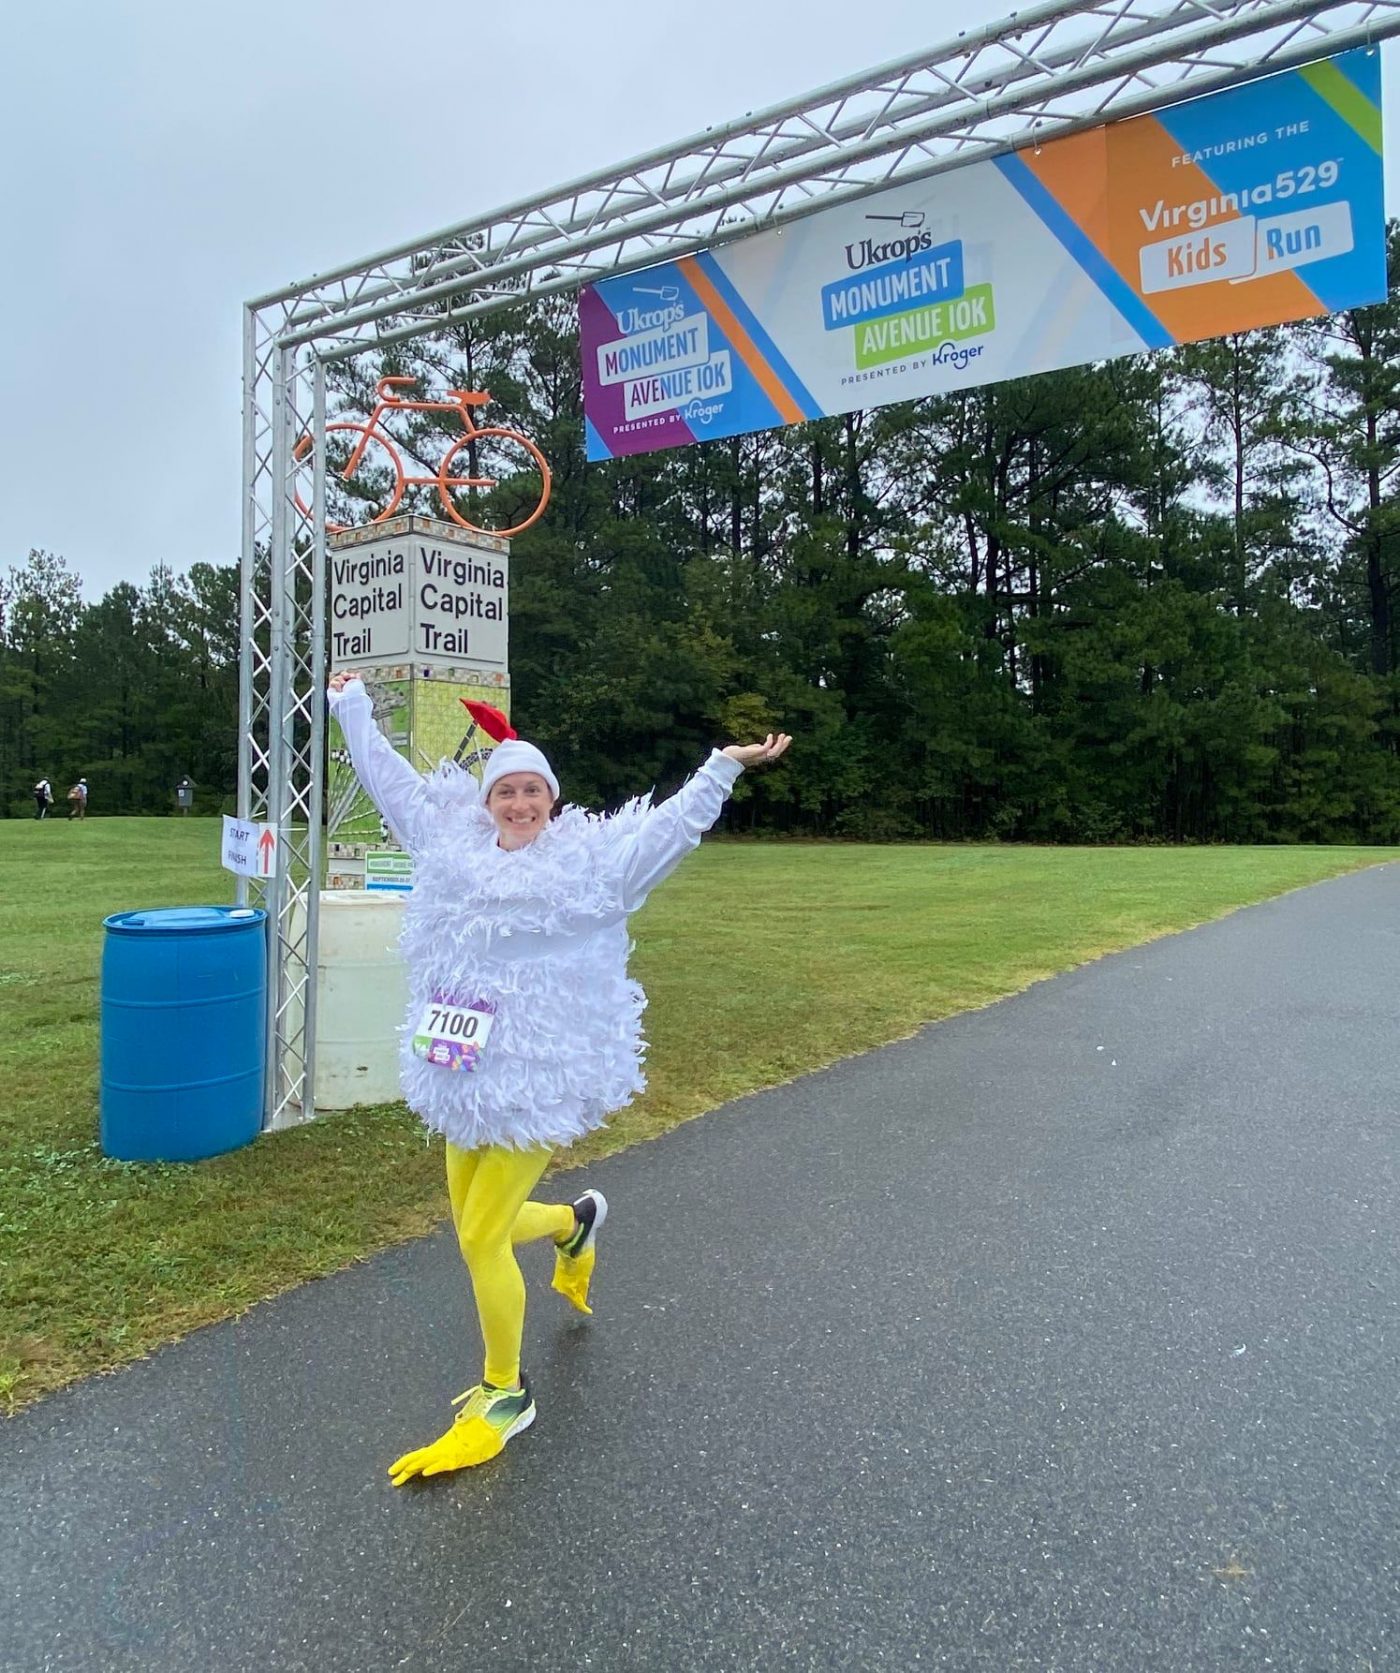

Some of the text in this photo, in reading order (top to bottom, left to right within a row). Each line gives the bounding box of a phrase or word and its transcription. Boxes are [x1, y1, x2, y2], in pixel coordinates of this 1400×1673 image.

[1171, 120, 1310, 168] FEATURING THE
[1139, 160, 1339, 232] Virginia529
[845, 230, 932, 270] Ukrop's
[1167, 224, 1322, 278] Kids Run
[830, 257, 951, 321] MONUMENT
[616, 302, 685, 334] Ukrop's
[862, 296, 987, 355] AVENUE 10K
[605, 327, 699, 377] MONUMENT
[841, 342, 984, 385] PRESENTED BY Kroger
[630, 361, 727, 408] AVENUE 10K
[613, 399, 725, 433] PRESENTED BY Kroger
[334, 550, 404, 586] Virginia
[420, 547, 505, 588] Virginia
[333, 583, 402, 620] Capital
[420, 583, 502, 621] Capital
[333, 628, 371, 657] Trail
[420, 623, 468, 654] Trail
[428, 1010, 479, 1038] 7100
